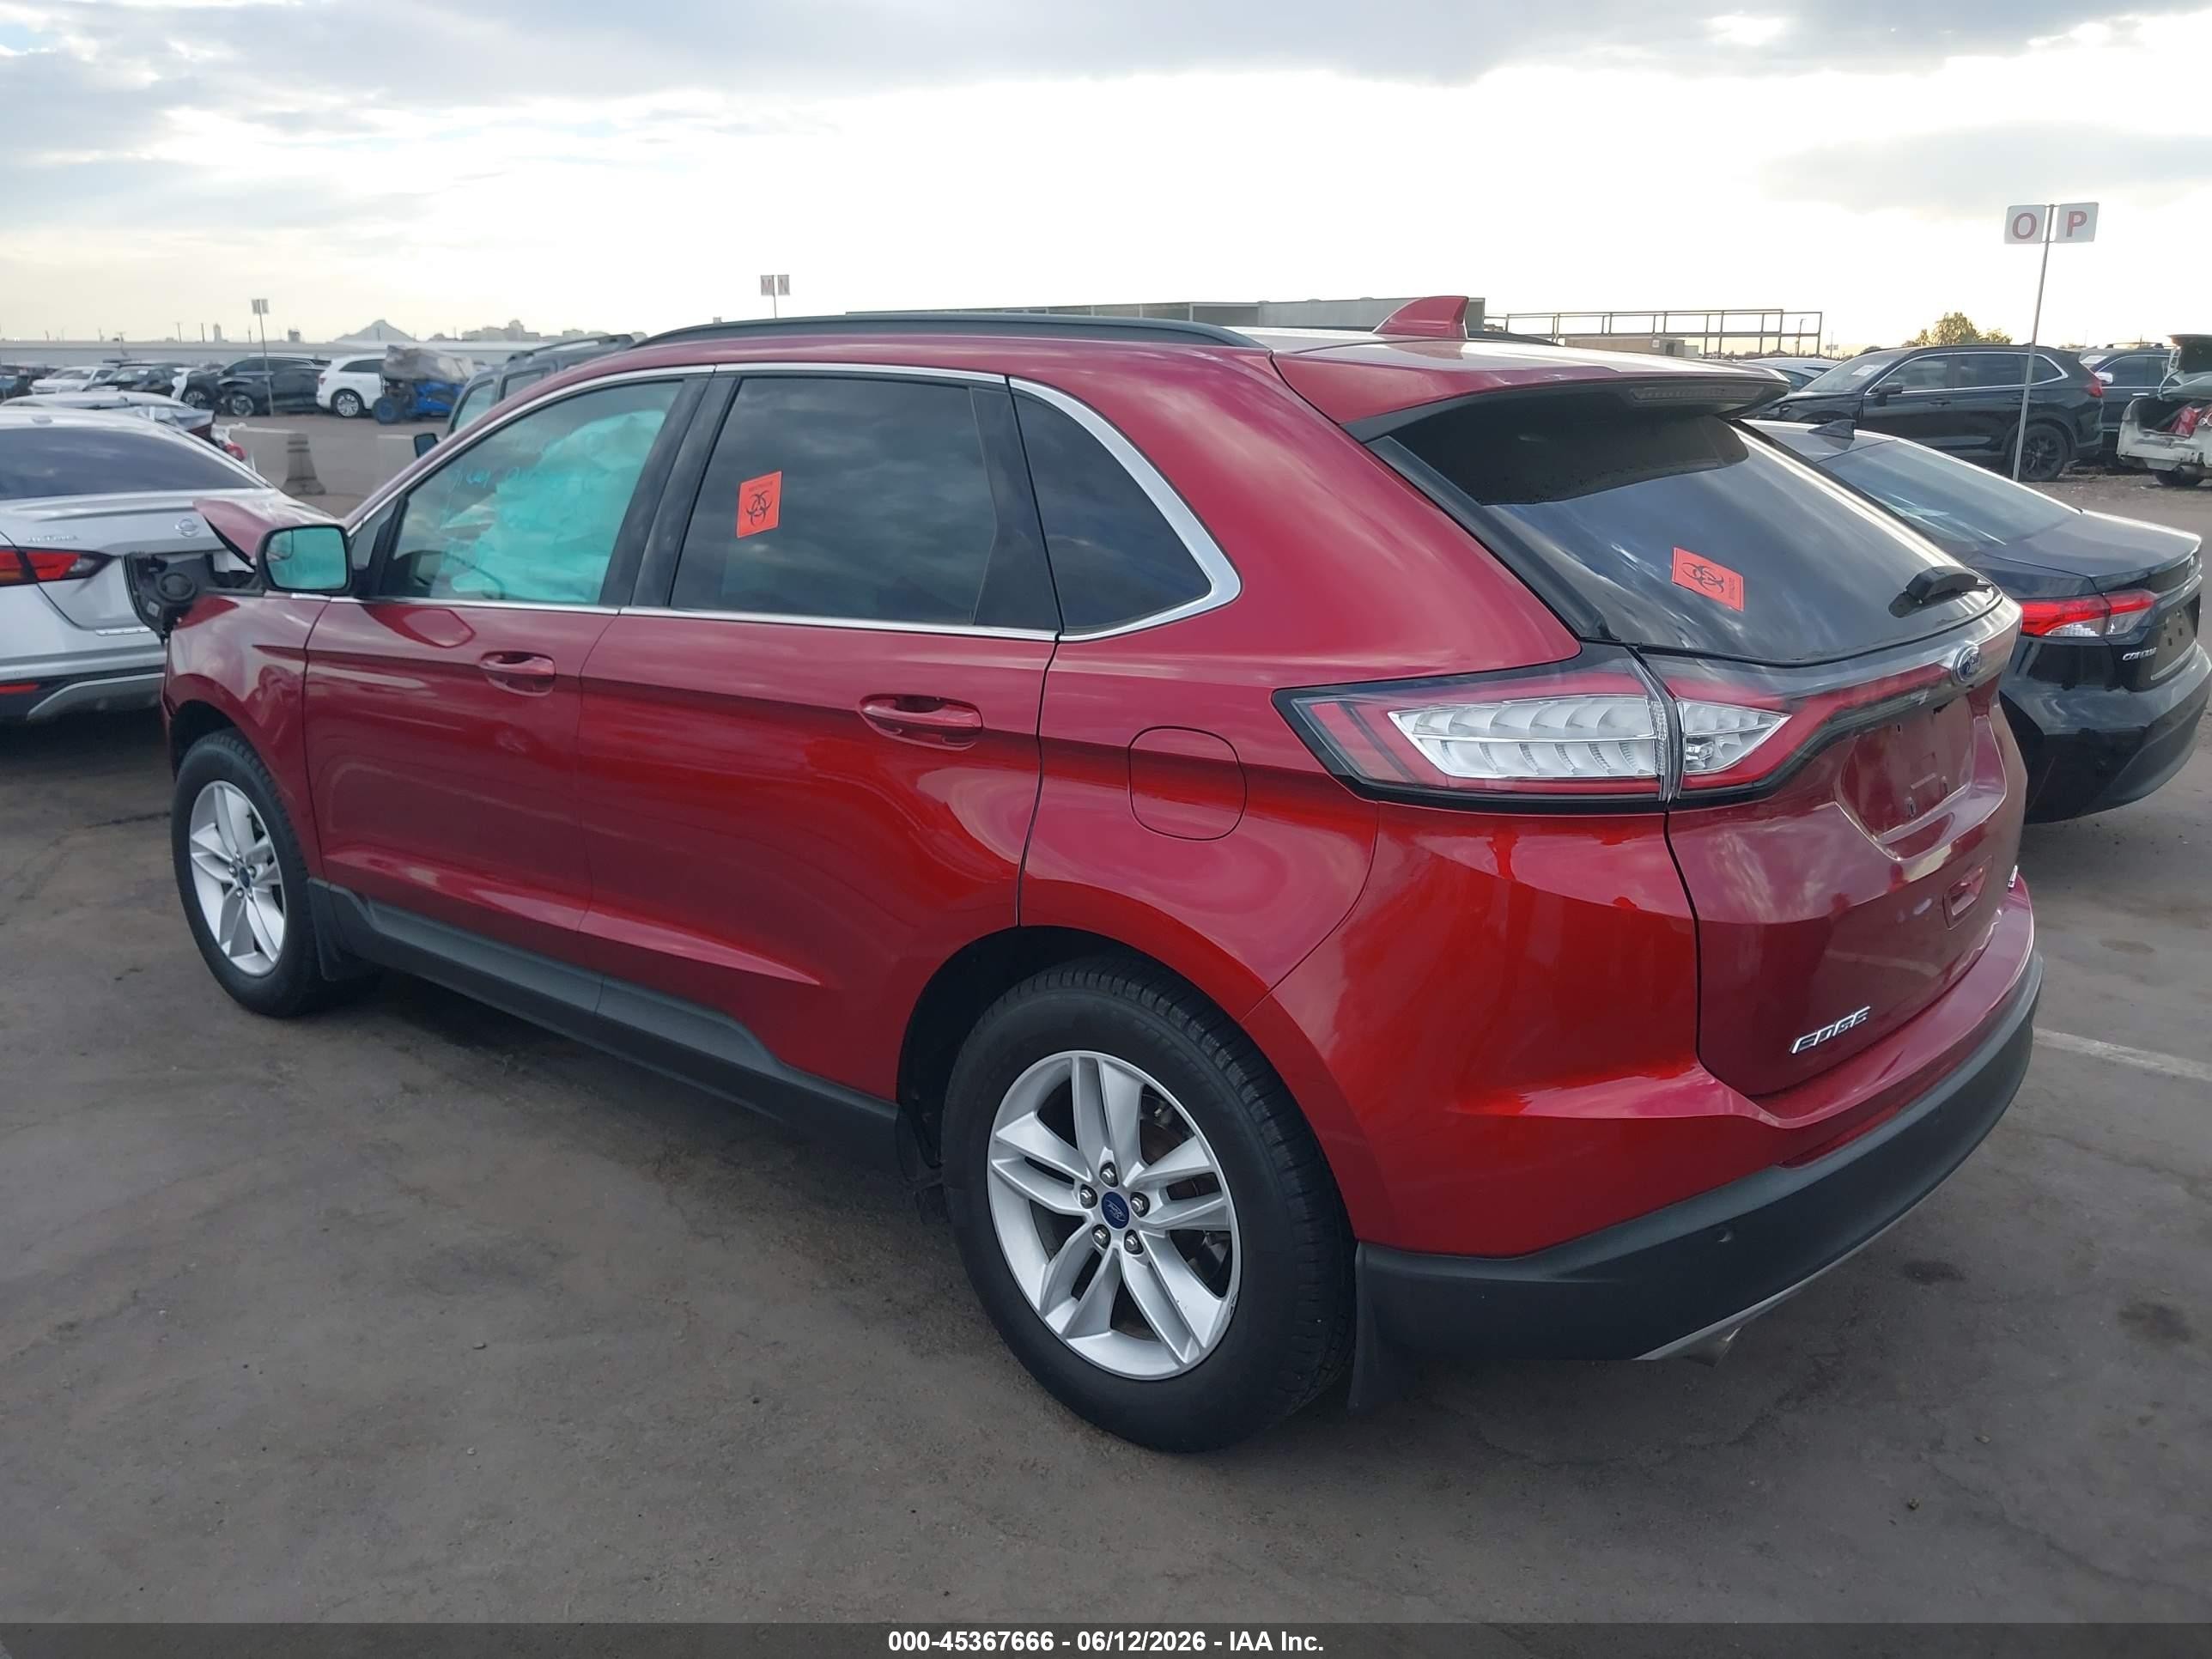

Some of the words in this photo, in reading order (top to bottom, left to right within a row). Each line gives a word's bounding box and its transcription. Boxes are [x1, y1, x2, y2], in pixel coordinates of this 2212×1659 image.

[2012, 212, 2037, 240] O
[2066, 210, 2087, 238] P
[1790, 1005, 1872, 1054] EDGE
